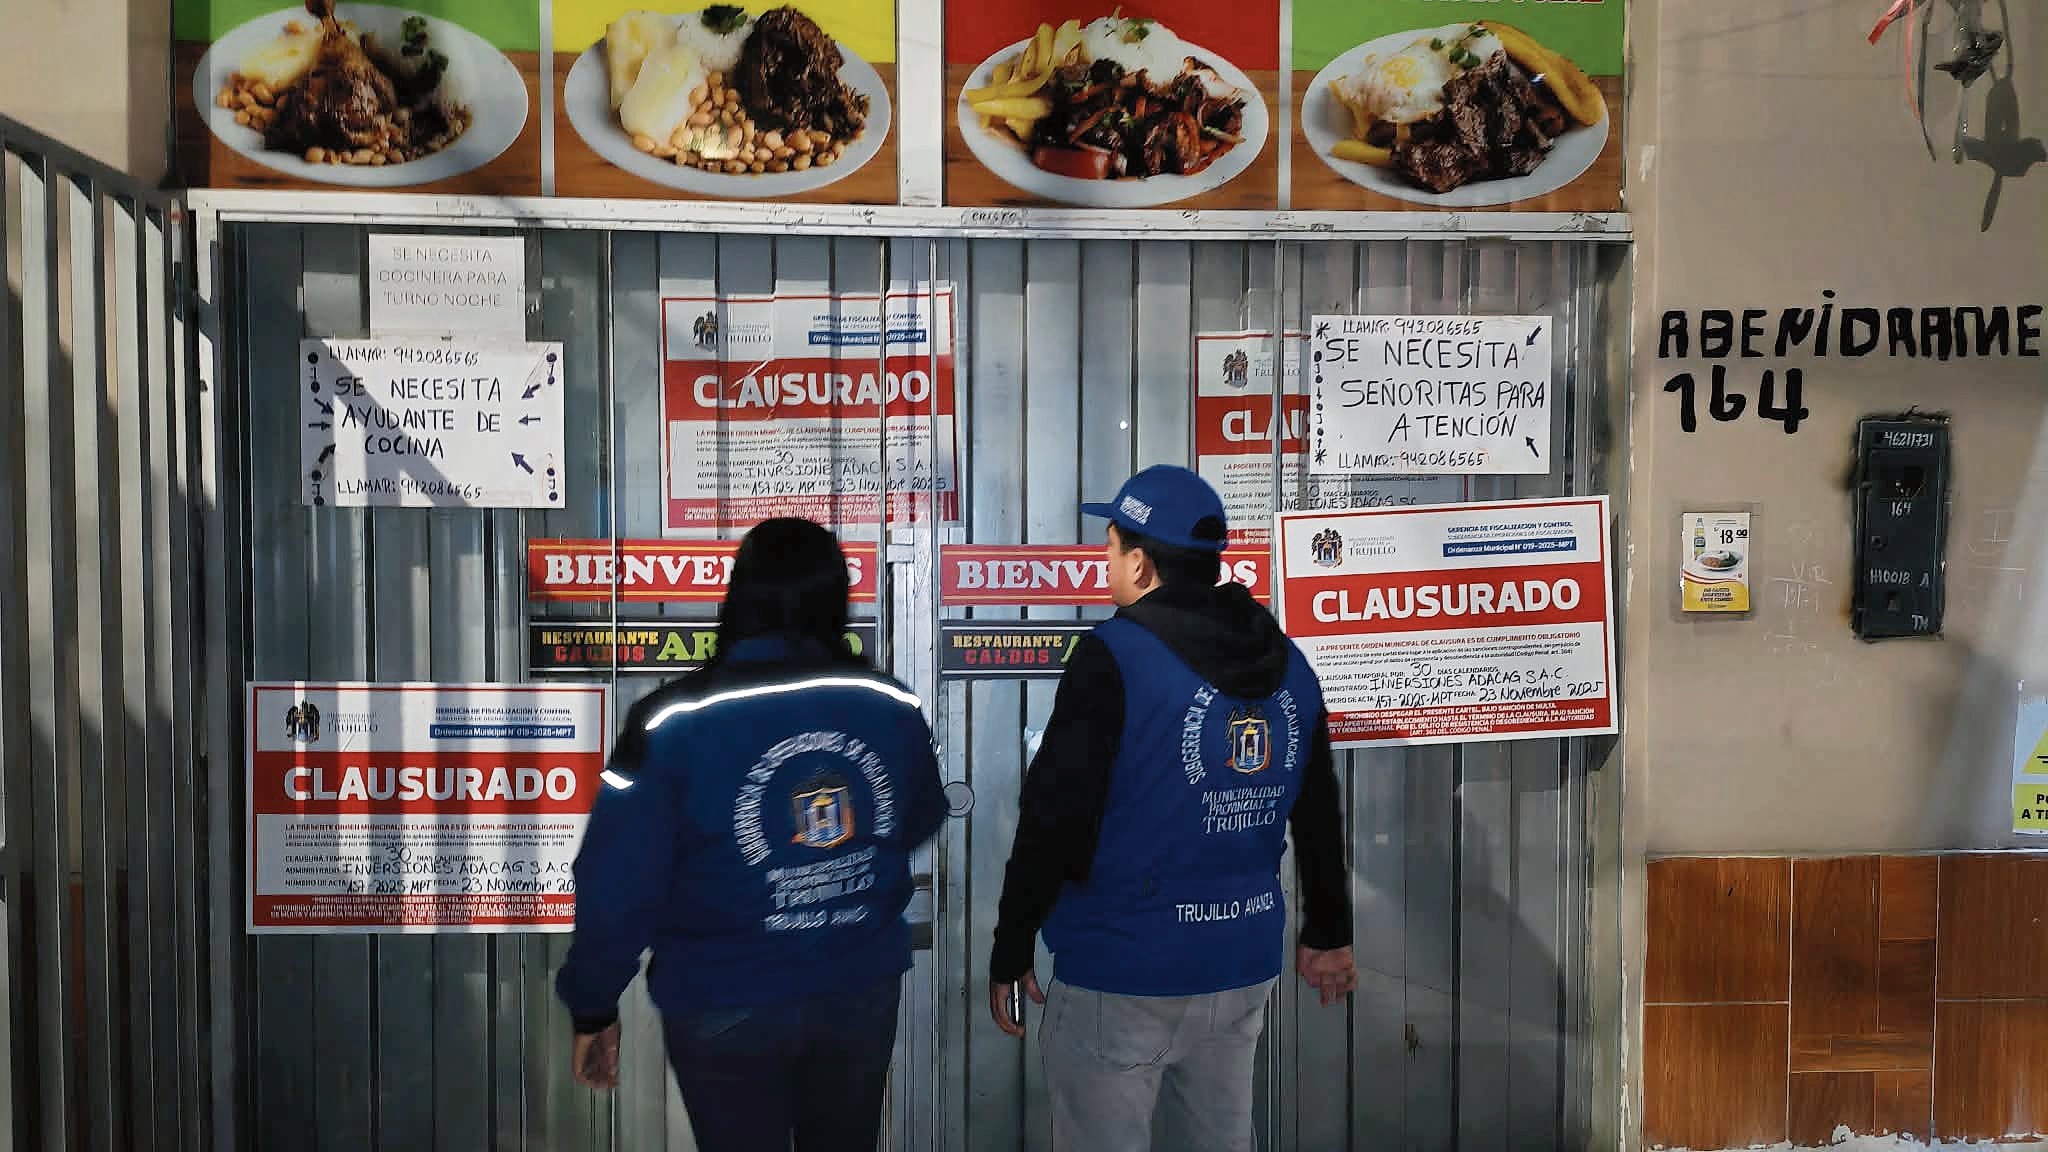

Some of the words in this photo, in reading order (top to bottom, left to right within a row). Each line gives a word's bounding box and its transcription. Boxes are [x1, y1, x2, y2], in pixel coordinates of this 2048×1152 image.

[467, 270, 508, 284] PARA
[1326, 338, 1360, 363] SE
[1384, 339, 1519, 369] NECESITA
[334, 376, 368, 397] SE
[390, 377, 503, 402] NECESITA
[693, 370, 931, 409] CLAUSURADO
[1341, 377, 1488, 408] SEÑORITAS
[1496, 380, 1546, 409] PARA
[1663, 364, 1810, 435] 164
[341, 404, 456, 431] AYUDANTE
[476, 410, 502, 434] DE
[364, 434, 445, 459] COCINA
[1890, 501, 1913, 517] 164
[1349, 545, 1397, 558] TRUJILLO
[1312, 578, 1581, 623] CLAUSURADO
[541, 631, 659, 645] RESTAURANTE
[952, 634, 1064, 648] RESTAURANTE
[1385, 640, 1420, 649] MUNICIPAL
[1431, 637, 1466, 646] CLAUSURA
[1486, 633, 1537, 643] CUMPLIMIENTO
[1537, 631, 1581, 640] OBLIGATORIO
[554, 646, 646, 662] CALDOS
[964, 649, 1050, 665] CALDOS
[1410, 662, 1432, 677] 30
[1468, 670, 1521, 686] ADACAG
[1479, 687, 1498, 702] 23
[284, 767, 577, 801] CLAUSURADO
[1201, 785, 1286, 806] MUNICIPALIDAD
[1202, 811, 1276, 835] TRUJILLO
[385, 846, 412, 864] 30
[342, 861, 454, 875] INVERSIONES
[459, 860, 525, 875] ADACAG
[461, 876, 483, 893] 23
[1174, 901, 1240, 923] TRUJILLO
